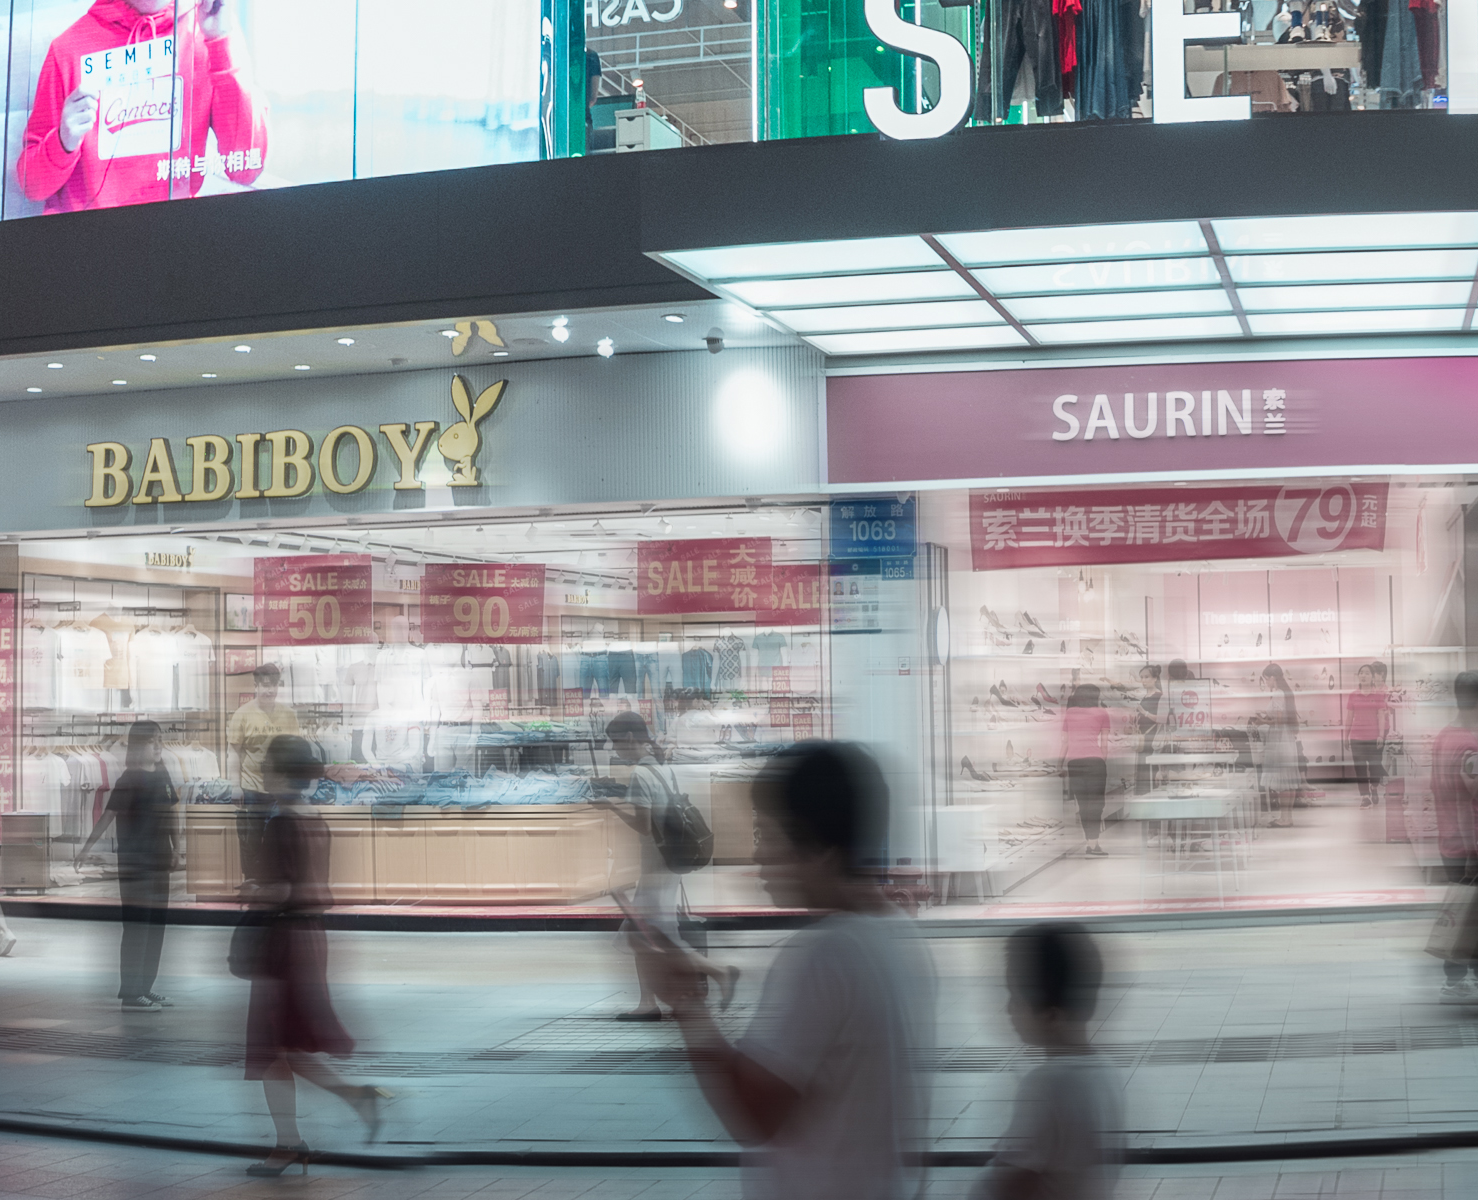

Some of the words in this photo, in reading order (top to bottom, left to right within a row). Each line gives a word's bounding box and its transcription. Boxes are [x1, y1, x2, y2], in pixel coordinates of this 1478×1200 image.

[84, 38, 174, 74] SEMIR
[1052, 388, 1253, 441] SAURIN
[1262, 388, 1287, 435] 索兰
[84, 420, 440, 508] BABIBOY
[983, 492, 1021, 504] SAURIN
[841, 504, 904, 520] 解放路
[982, 499, 1270, 552] 索兰换季清货全场
[1282, 486, 1358, 543] 79
[1360, 494, 1379, 529] 元起
[849, 520, 897, 541] 1063
[289, 573, 338, 592] SALE
[453, 569, 506, 589] SALE
[647, 559, 719, 596] SALE
[730, 544, 758, 608] 大减价
[884, 567, 912, 579] 1065-1
[288, 594, 342, 640] 50
[453, 595, 511, 639] 90
[1203, 611, 1226, 625] The
[1280, 609, 1294, 623] of
[1299, 608, 1336, 623] watch
[1177, 710, 1206, 728] 149
